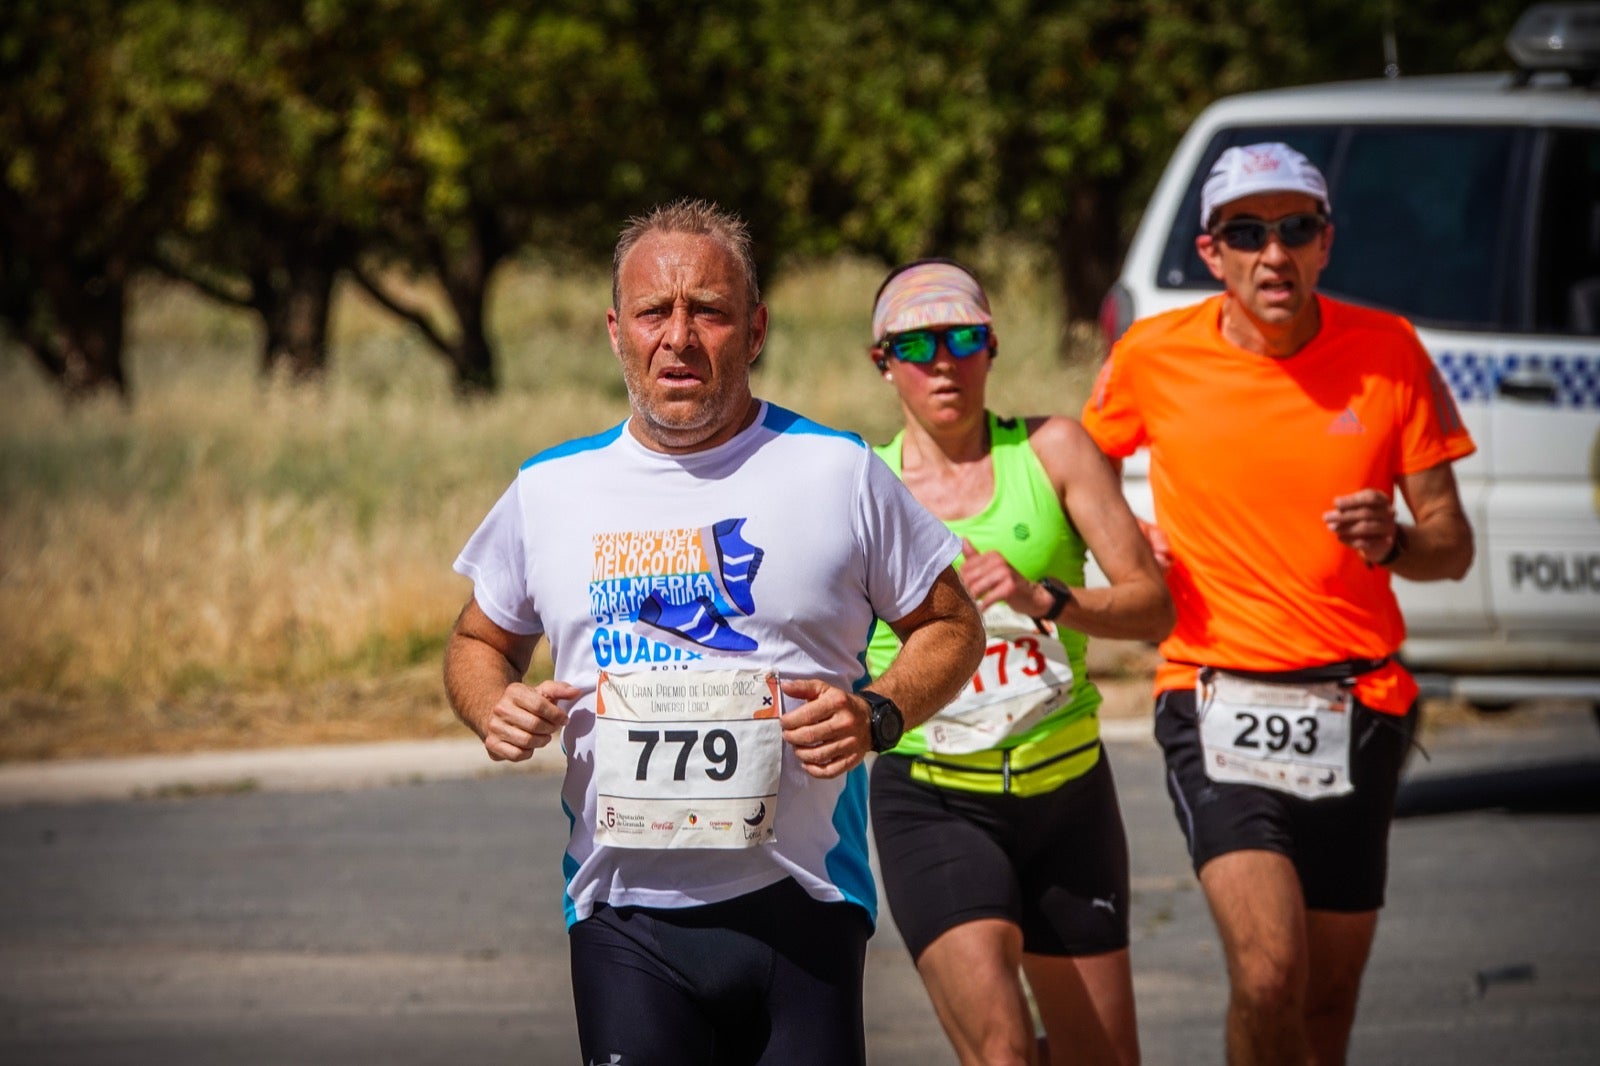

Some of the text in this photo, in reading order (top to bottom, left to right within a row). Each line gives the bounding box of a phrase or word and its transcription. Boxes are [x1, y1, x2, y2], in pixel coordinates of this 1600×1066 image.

[630, 528, 678, 541] PRUEBA
[682, 527, 698, 538] DE
[593, 536, 698, 556] FONDO DEL
[589, 574, 711, 595] XII MEDIA
[592, 627, 703, 668] GUADIX
[650, 664, 689, 672] 2019
[732, 681, 756, 696] 2022
[1233, 712, 1319, 755] 293
[628, 728, 738, 782] 779
